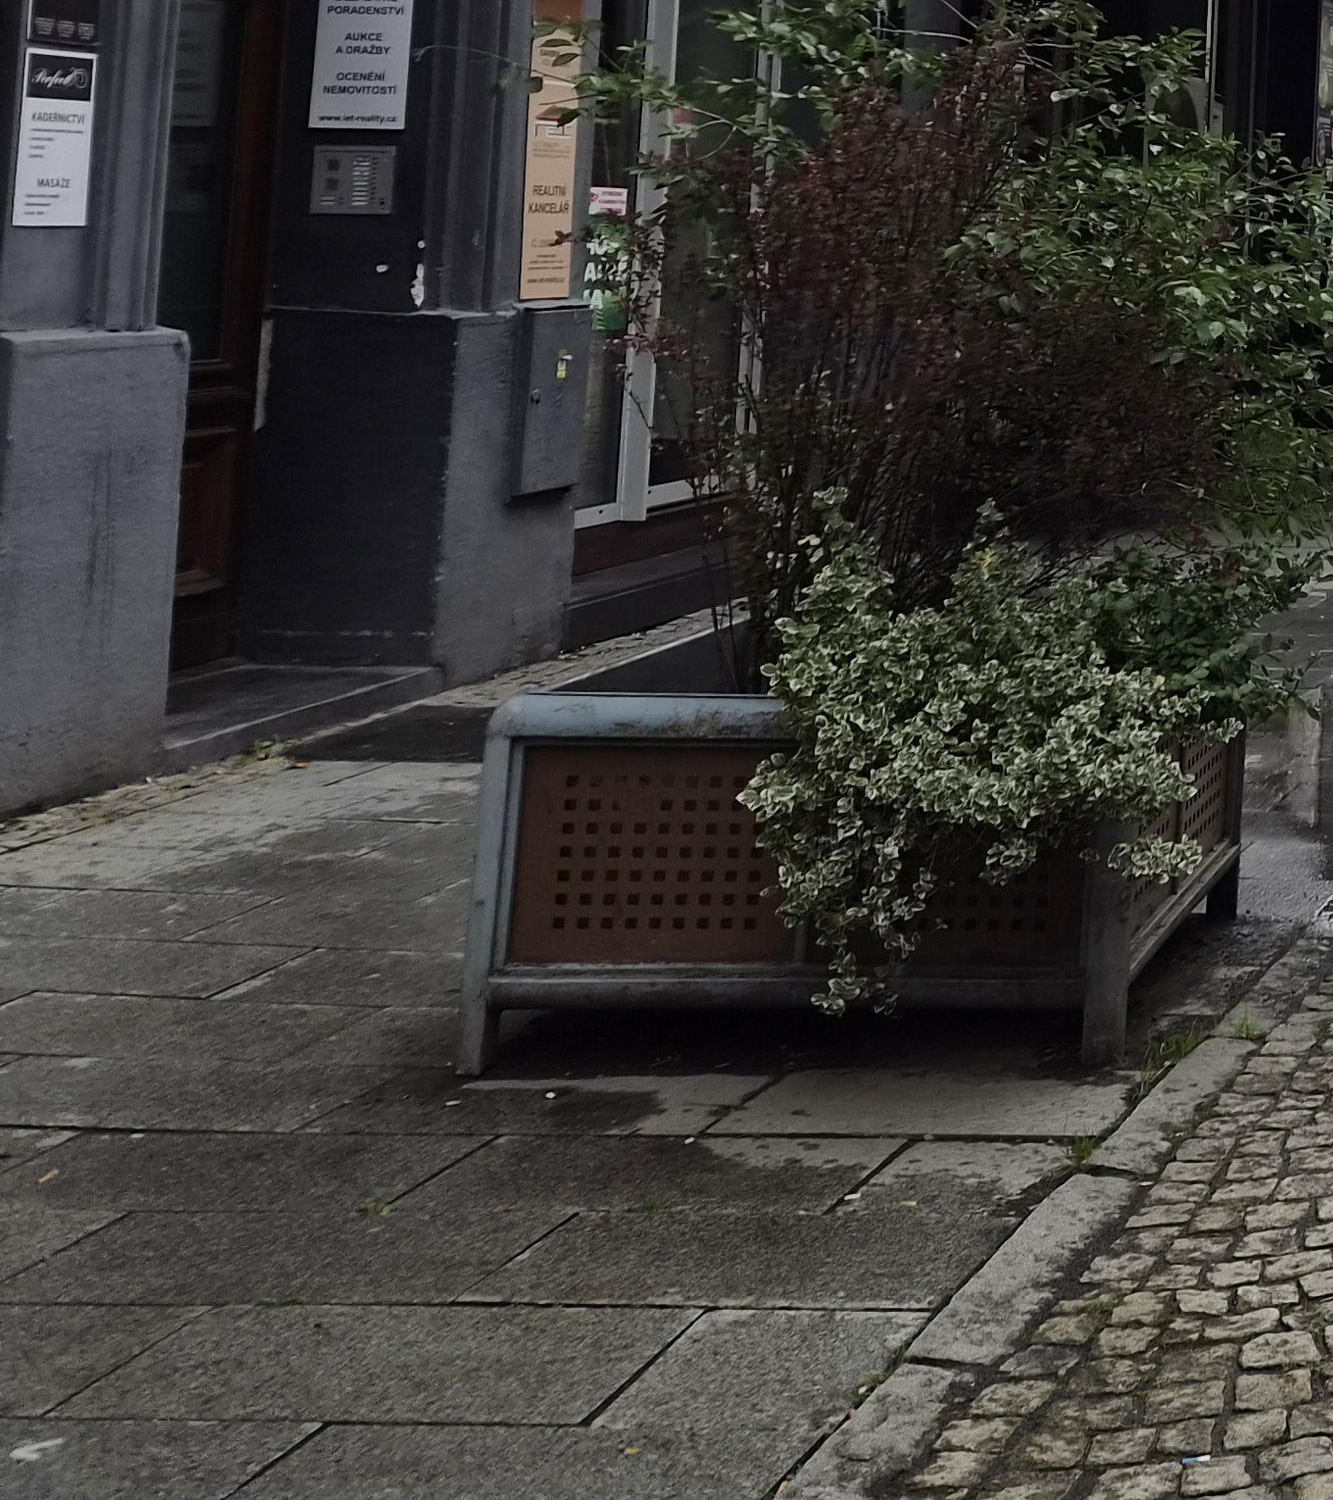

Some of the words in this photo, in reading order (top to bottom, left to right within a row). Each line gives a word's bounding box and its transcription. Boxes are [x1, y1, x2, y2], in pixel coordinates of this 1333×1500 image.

[327, 4, 405, 15] PORADENSTVÍ
[344, 32, 384, 42] AUKCE
[335, 46, 344, 54] A
[345, 44, 391, 55] DRAŽBY
[336, 71, 385, 82] OCENĚNÍ
[322, 85, 397, 95] NEMOVITOSTÍ
[31, 112, 86, 125] KADEŘNICTVÍ
[37, 177, 71, 189] MASÁŽE
[532, 184, 567, 197] REALITNÍ
[528, 199, 570, 214] KANCELÁŘ
